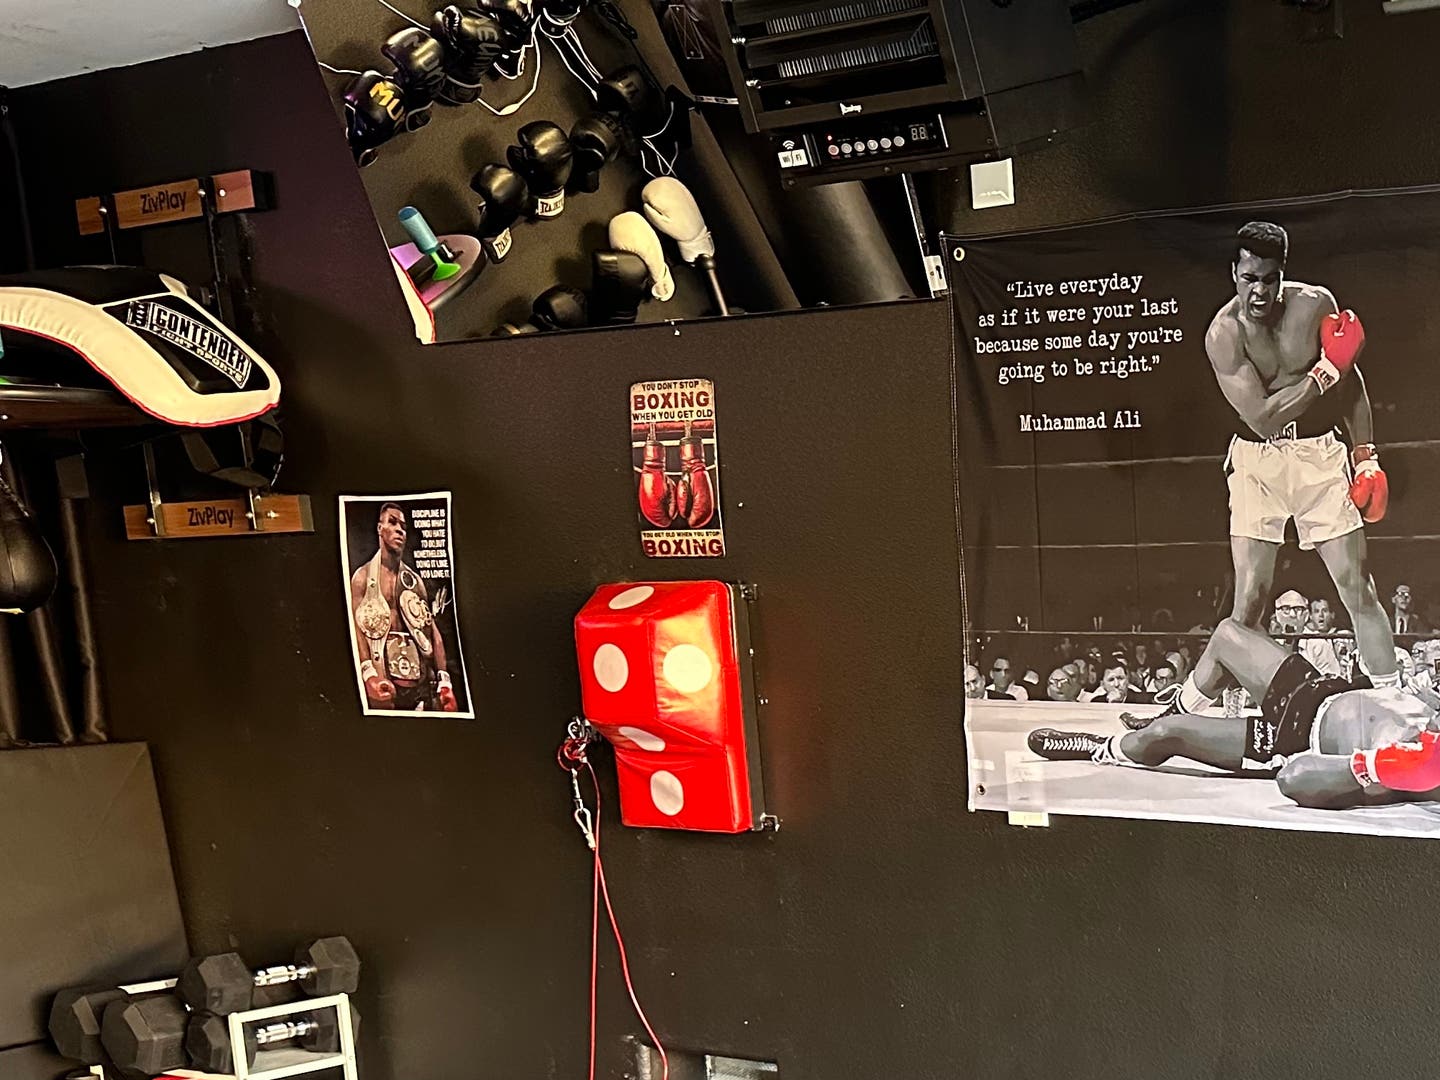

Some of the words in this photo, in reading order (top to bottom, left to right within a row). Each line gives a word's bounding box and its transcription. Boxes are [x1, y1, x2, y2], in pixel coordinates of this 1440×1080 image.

[140, 190, 187, 214] ZivPlay
[1059, 273, 1143, 296] everyday
[978, 313, 995, 327] as
[1001, 309, 1018, 326] if
[1024, 307, 1041, 324] it
[1046, 307, 1086, 322] were
[1092, 304, 1135, 324] your
[1140, 298, 1179, 316] last
[155, 306, 248, 373] CONTENDER
[974, 336, 1040, 354] because
[1044, 335, 1082, 350] some
[1088, 330, 1121, 350] day
[196, 349, 244, 382] SPORTS
[998, 362, 1045, 385] going
[1051, 361, 1068, 376] to
[1074, 358, 1094, 375] be
[642, 383, 656, 391] YOU
[680, 381, 699, 389] STOP
[633, 391, 710, 411] BOXING
[632, 412, 656, 421] WHEN
[658, 411, 675, 419] YOU
[677, 410, 694, 418] GET
[696, 409, 713, 418] OLD
[1019, 412, 1107, 431] Muhammad
[1113, 410, 1142, 428] Ali
[187, 506, 234, 528] ZivPlay
[643, 539, 723, 555] BOXING
